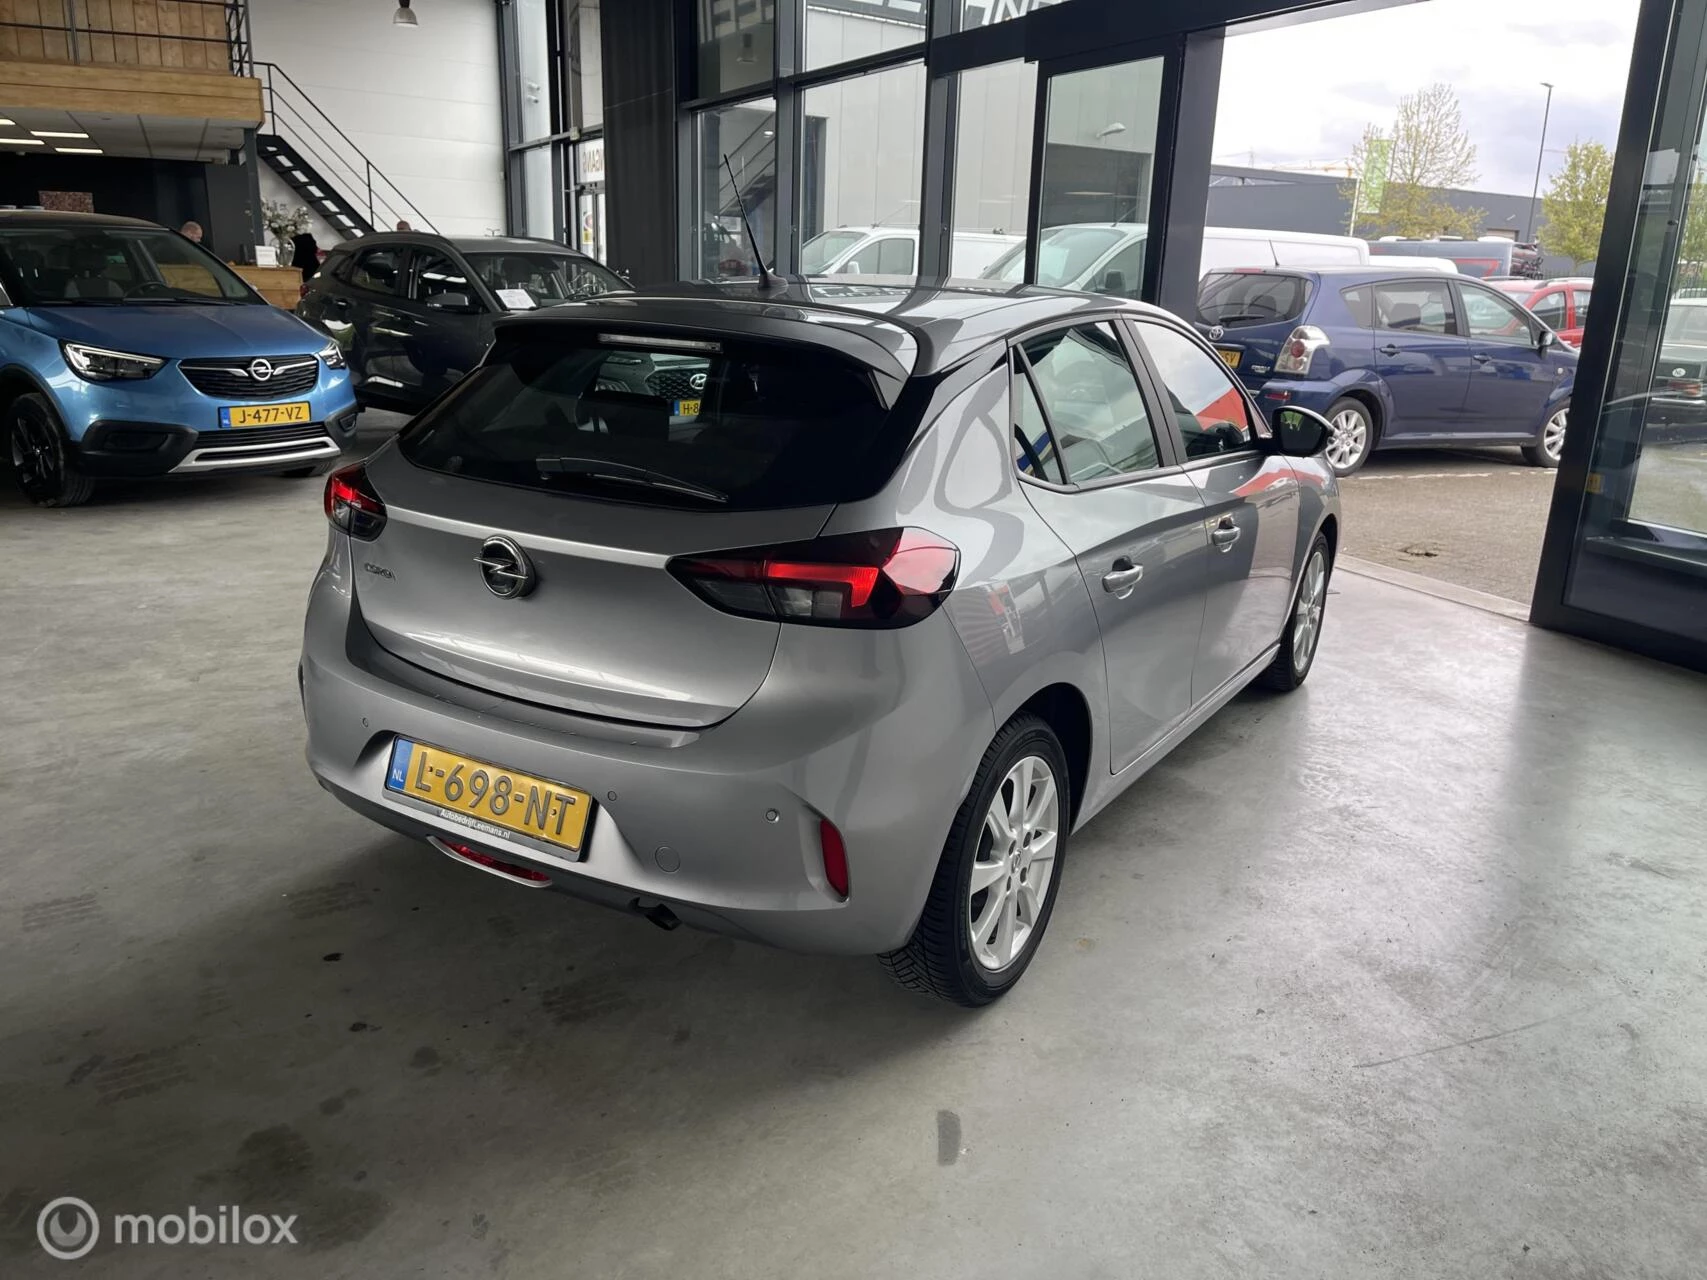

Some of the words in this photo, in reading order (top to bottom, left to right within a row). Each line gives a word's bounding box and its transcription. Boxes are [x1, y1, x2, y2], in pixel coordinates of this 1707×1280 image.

[239, 406, 303, 424] J-477-VZ
[391, 768, 404, 783] NL
[415, 751, 576, 835] L-698-NT
